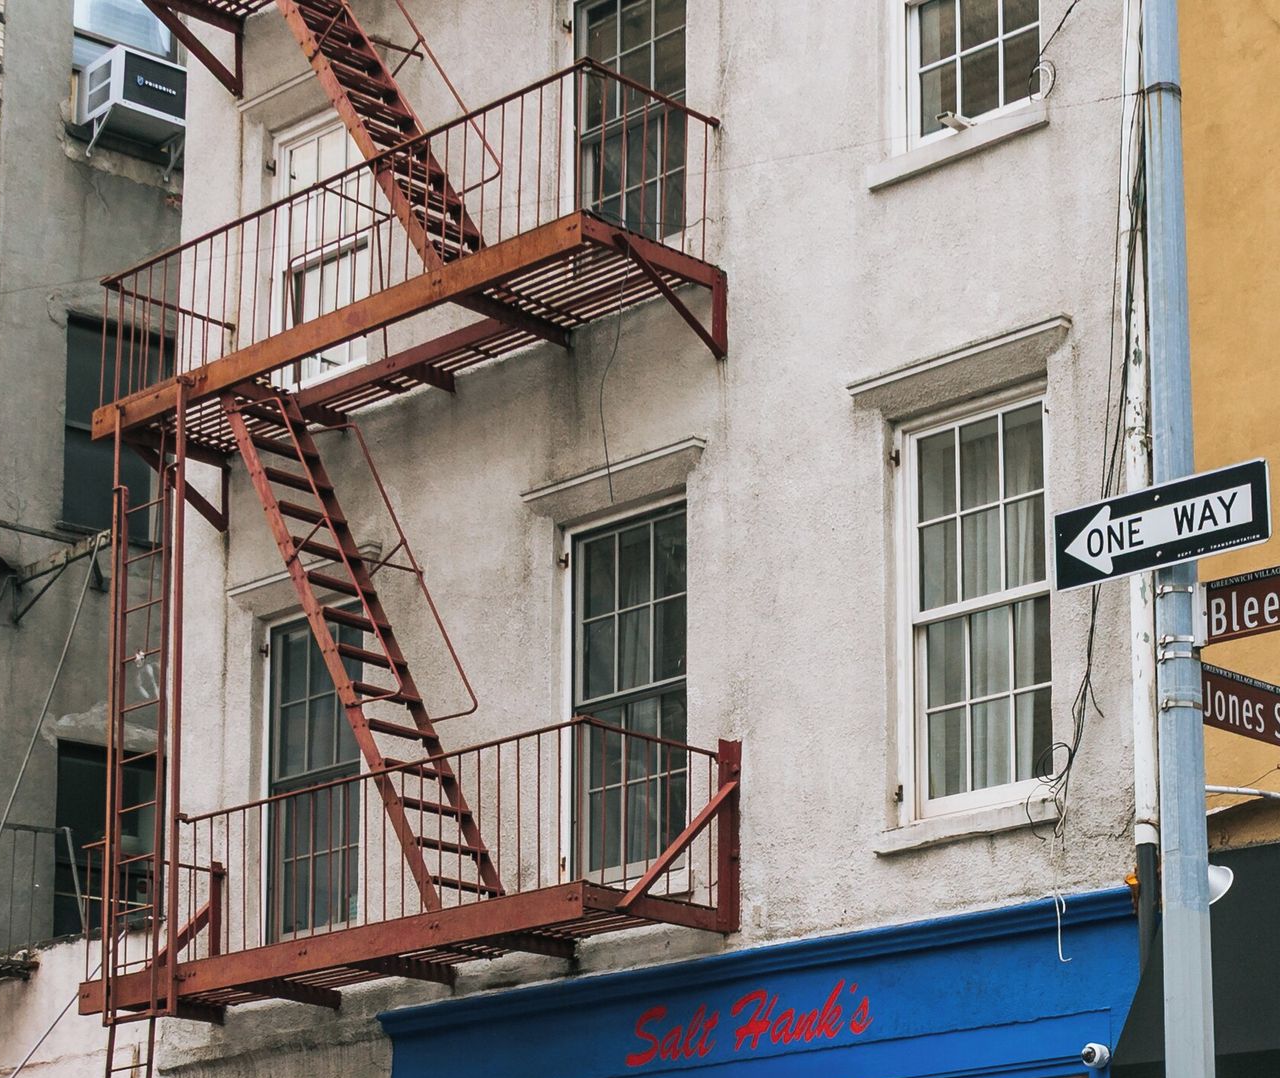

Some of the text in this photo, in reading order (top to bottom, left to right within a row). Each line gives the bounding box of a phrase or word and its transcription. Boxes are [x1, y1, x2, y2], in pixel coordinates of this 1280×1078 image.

[1087, 491, 1238, 558] ONE WAY
[1210, 573, 1253, 589] GREENWICH
[1204, 681, 1265, 733] Jones
[624, 977, 874, 1069] Salt Hank's
